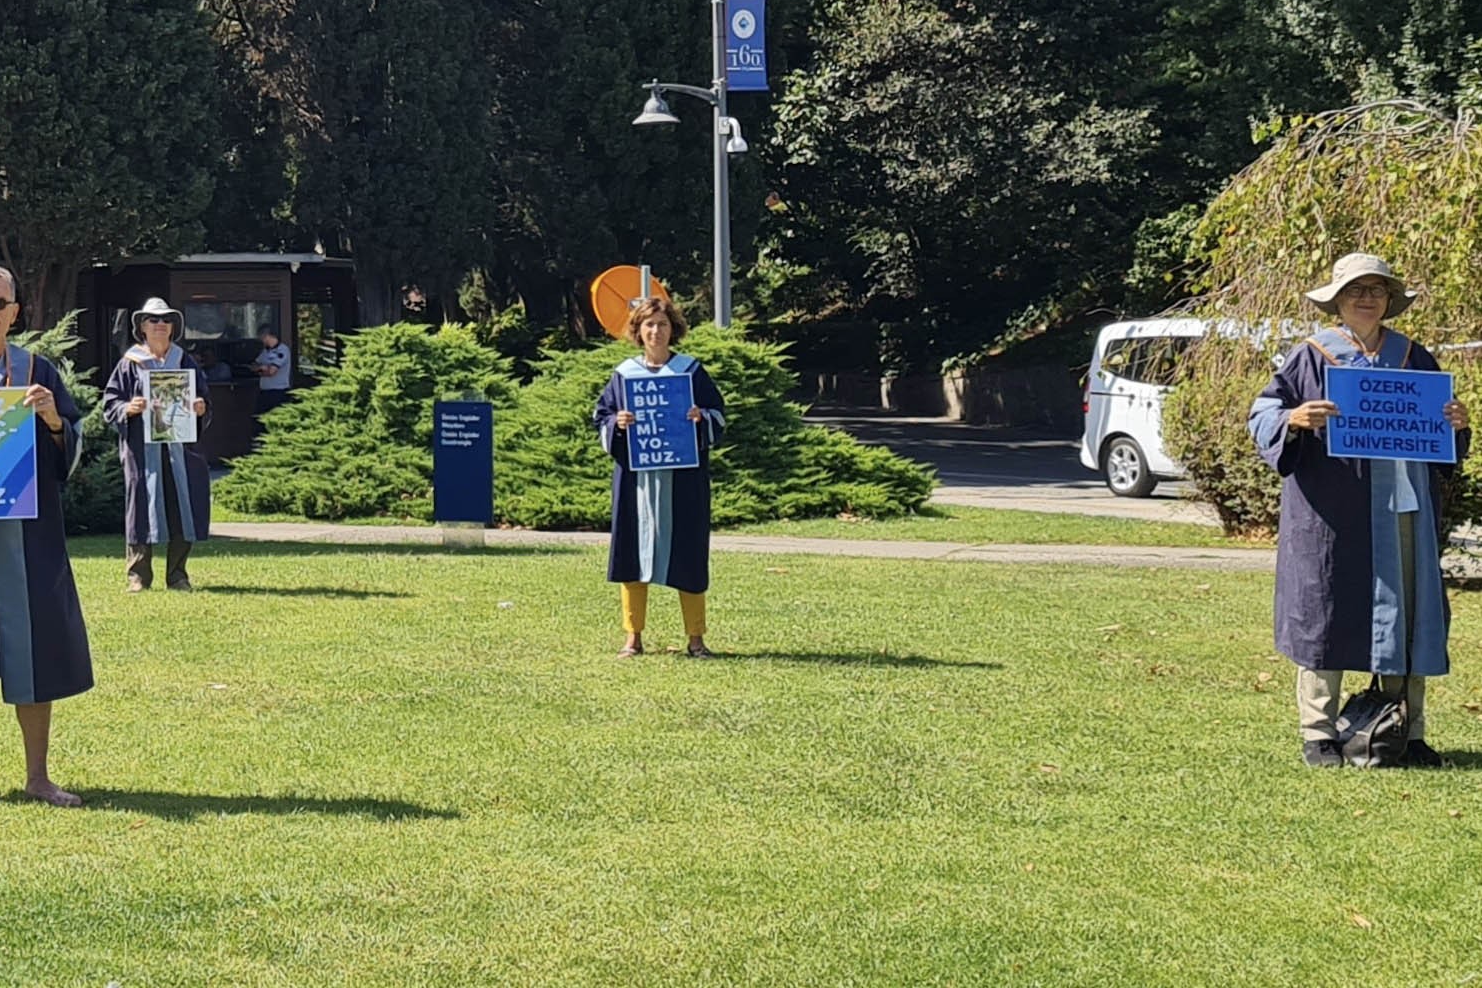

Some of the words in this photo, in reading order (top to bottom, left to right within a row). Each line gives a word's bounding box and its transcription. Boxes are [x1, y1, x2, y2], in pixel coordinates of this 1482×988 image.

[732, 44, 760, 66] 160
[632, 380, 666, 393] KA-
[1359, 377, 1421, 397] ÖZERK,
[633, 394, 669, 407] BUL
[1359, 396, 1423, 417] ÖZGÜR,
[635, 409, 663, 421] ET-
[1335, 416, 1445, 434] DEMOKRATİK
[638, 437, 670, 450] YO-
[1342, 432, 1440, 453] ÜNİVERSİTE
[639, 451, 680, 465] RUZ.
